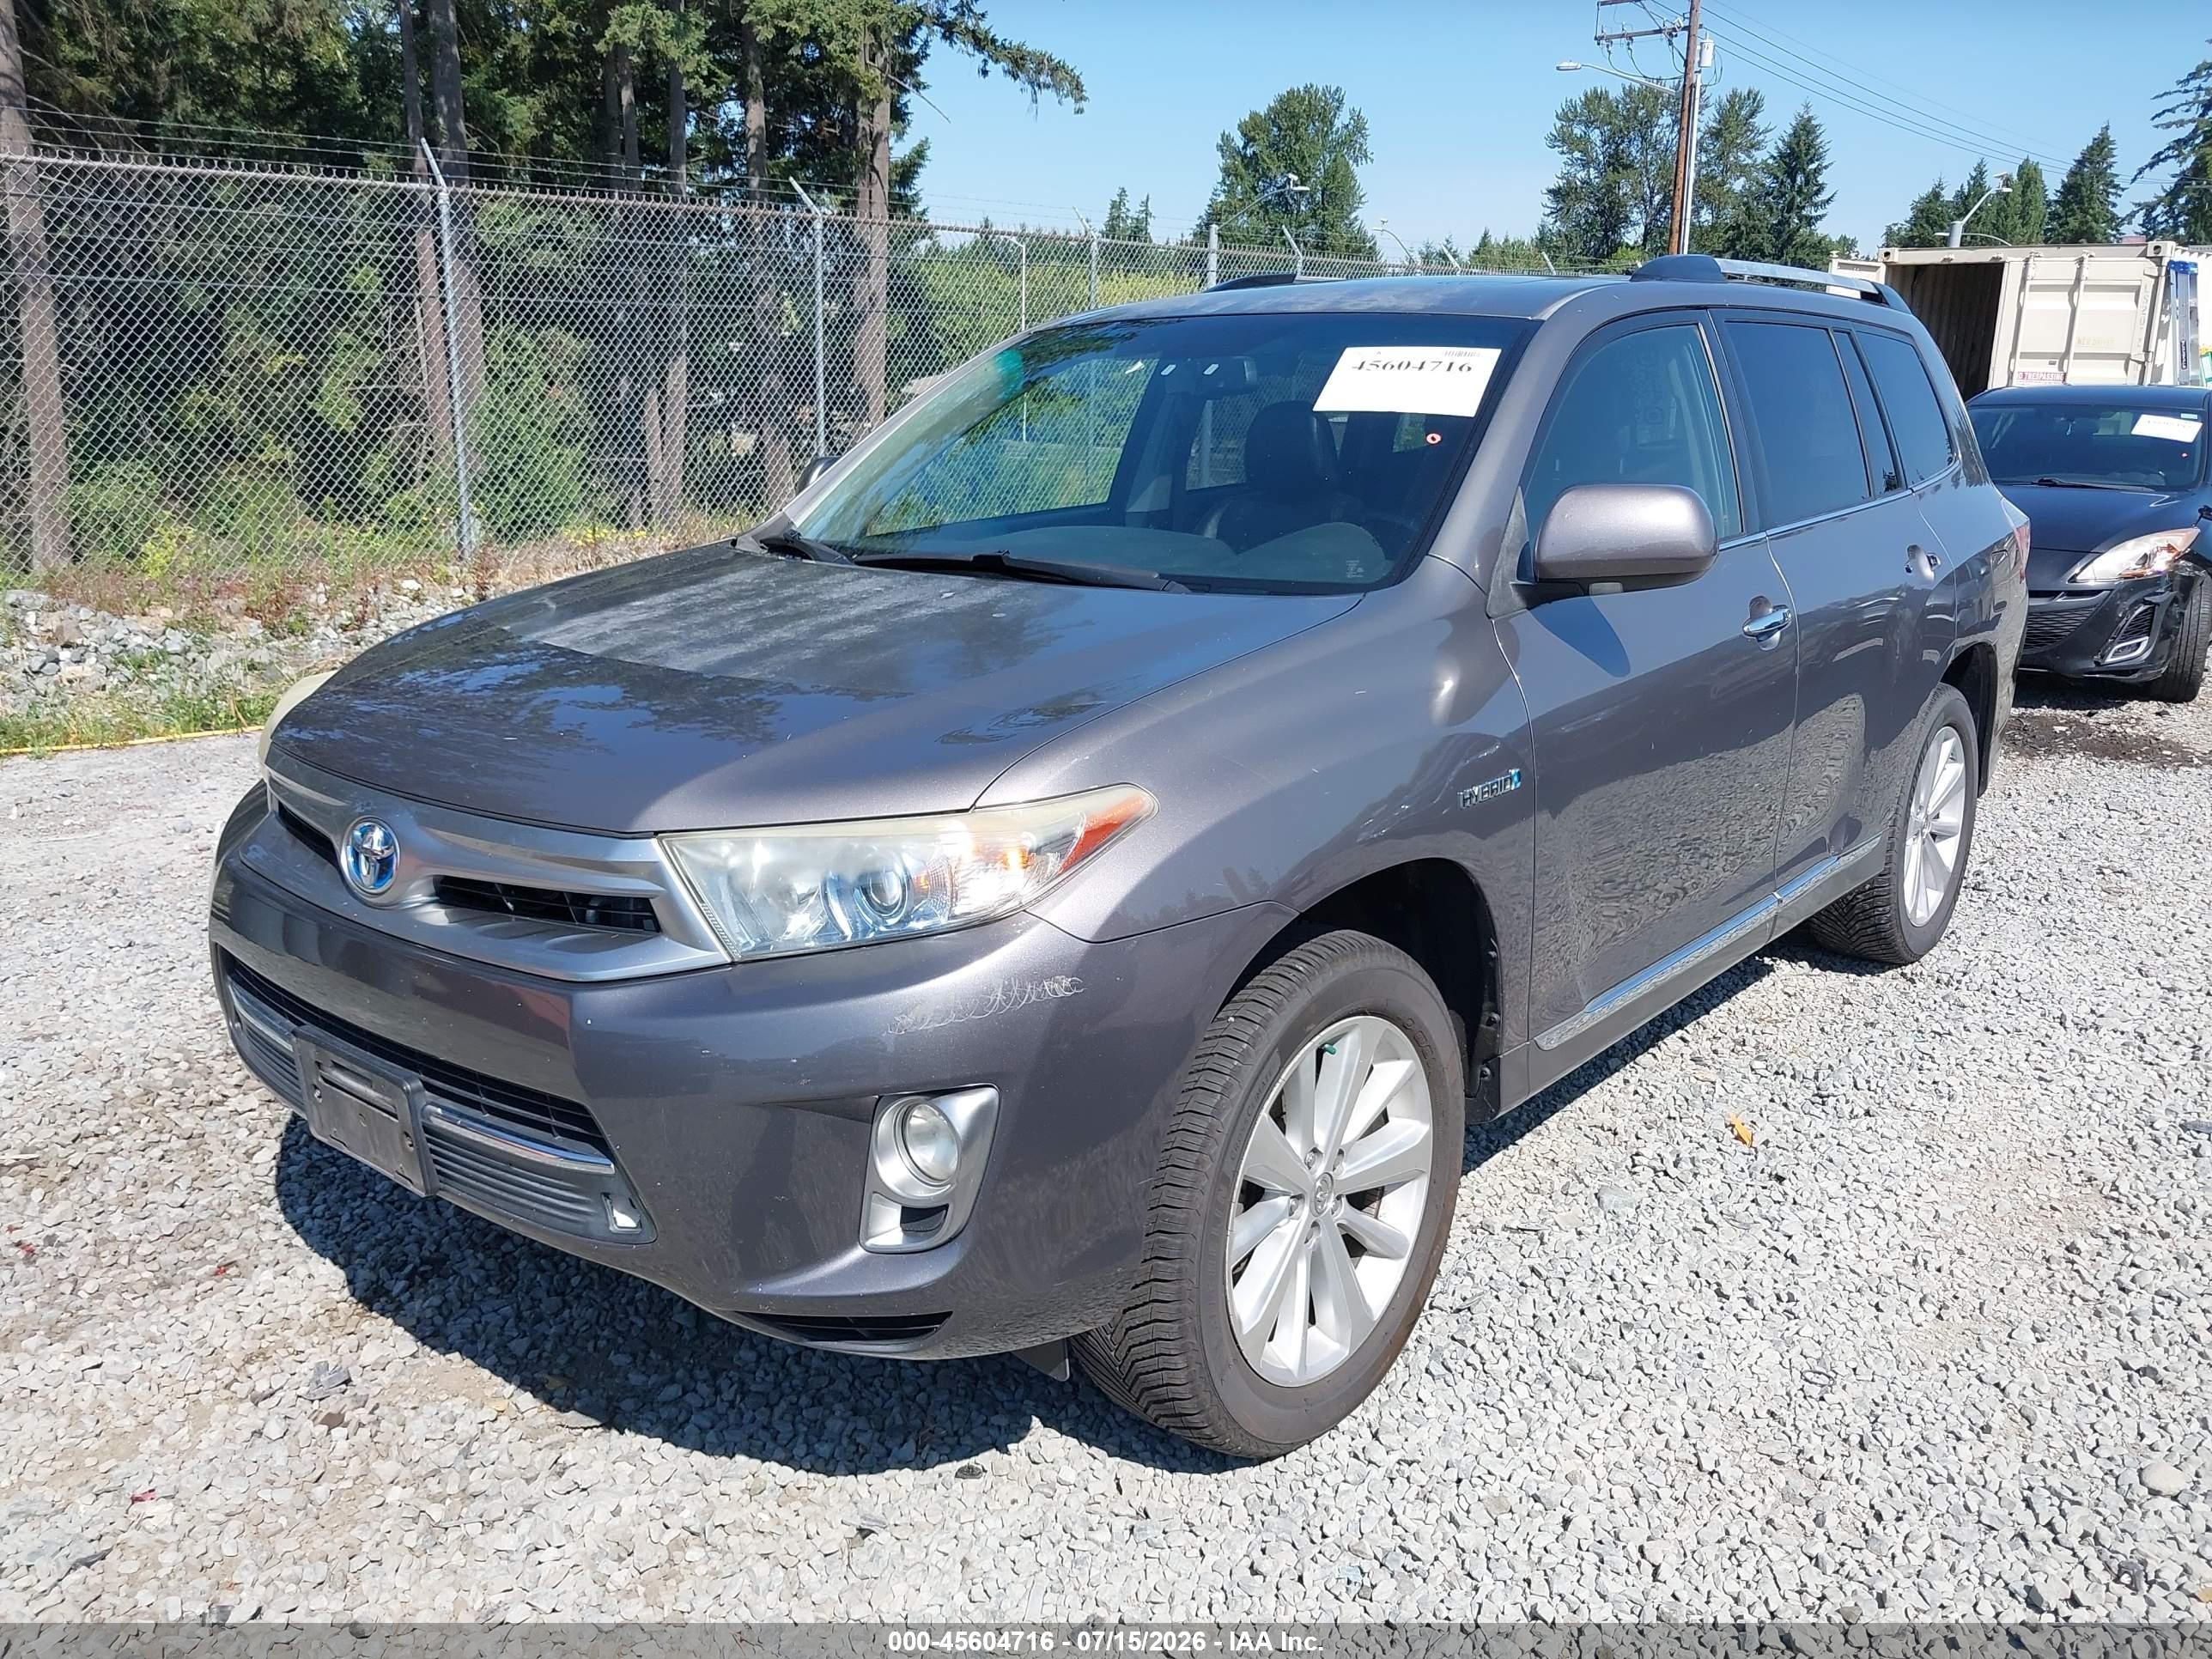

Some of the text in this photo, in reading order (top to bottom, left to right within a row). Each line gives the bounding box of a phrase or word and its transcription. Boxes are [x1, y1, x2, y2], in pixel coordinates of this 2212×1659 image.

[1351, 360, 1473, 373] 45604716
[2025, 372, 2064, 381] TRESPASSING
[1457, 775, 1511, 808] HYBRID
